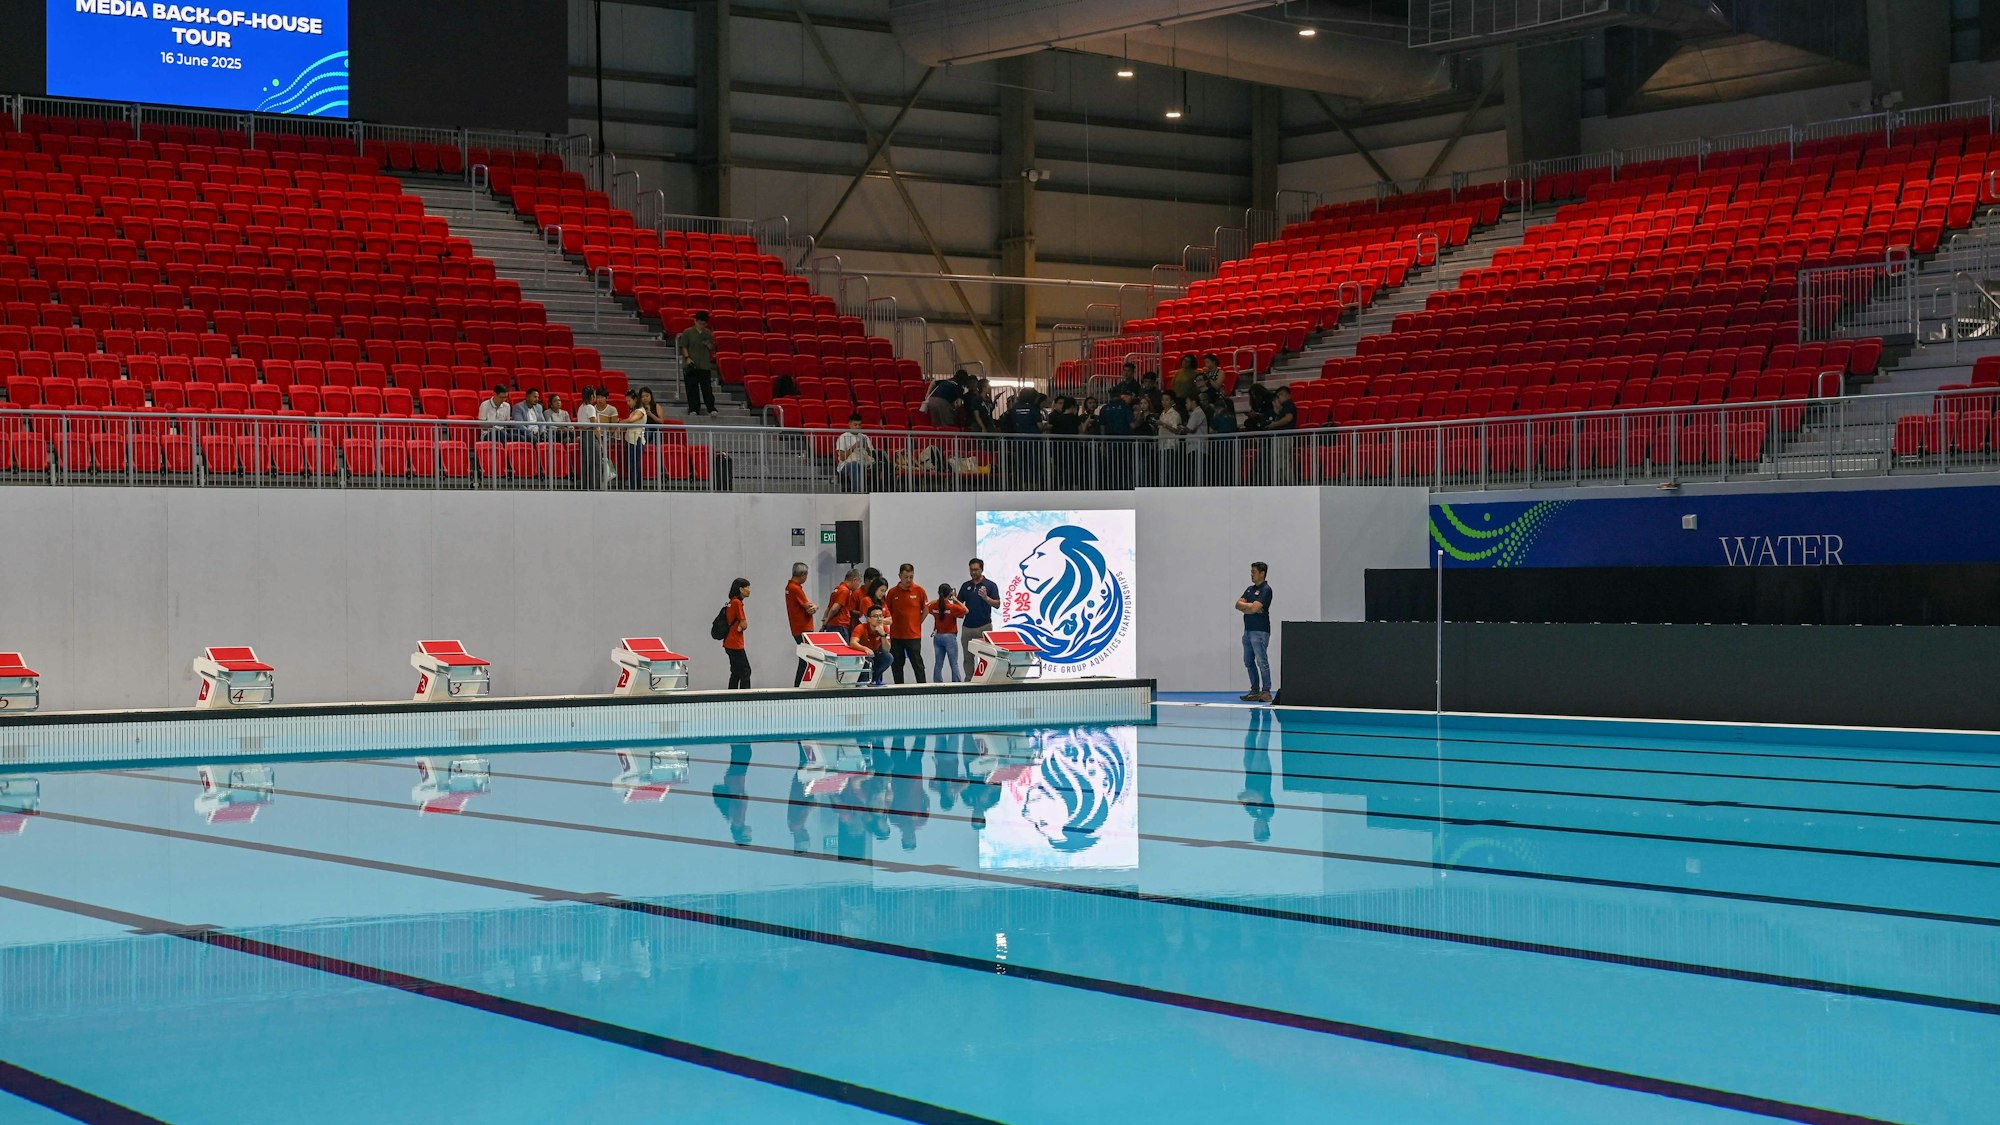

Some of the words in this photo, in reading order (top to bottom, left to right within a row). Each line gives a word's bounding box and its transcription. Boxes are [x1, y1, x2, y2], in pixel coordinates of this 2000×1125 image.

[76, 0, 148, 18] MEDIA
[152, 3, 323, 34] BACK-OF-HOUSE
[171, 27, 232, 48] TOUR
[160, 51, 175, 64] 16
[176, 53, 209, 67] June
[211, 56, 242, 70] 2025
[823, 532, 836, 542] EXIT
[1718, 534, 1844, 567] WATER
[1003, 575, 1023, 623] SINGAPORE
[1014, 592, 1030, 602] 20
[1015, 601, 1031, 612] 25
[1042, 663, 1057, 673] AGE
[1060, 662, 1087, 674] GROUP
[1090, 637, 1121, 668] AQUATICS
[1115, 571, 1132, 637] CHAMPIONSHIPS
[620, 672, 627, 686] 2
[807, 667, 813, 679] 1
[201, 684, 208, 699] 4
[419, 678, 426, 692] 3
[451, 682, 462, 695] 3
[232, 689, 244, 702] 4
